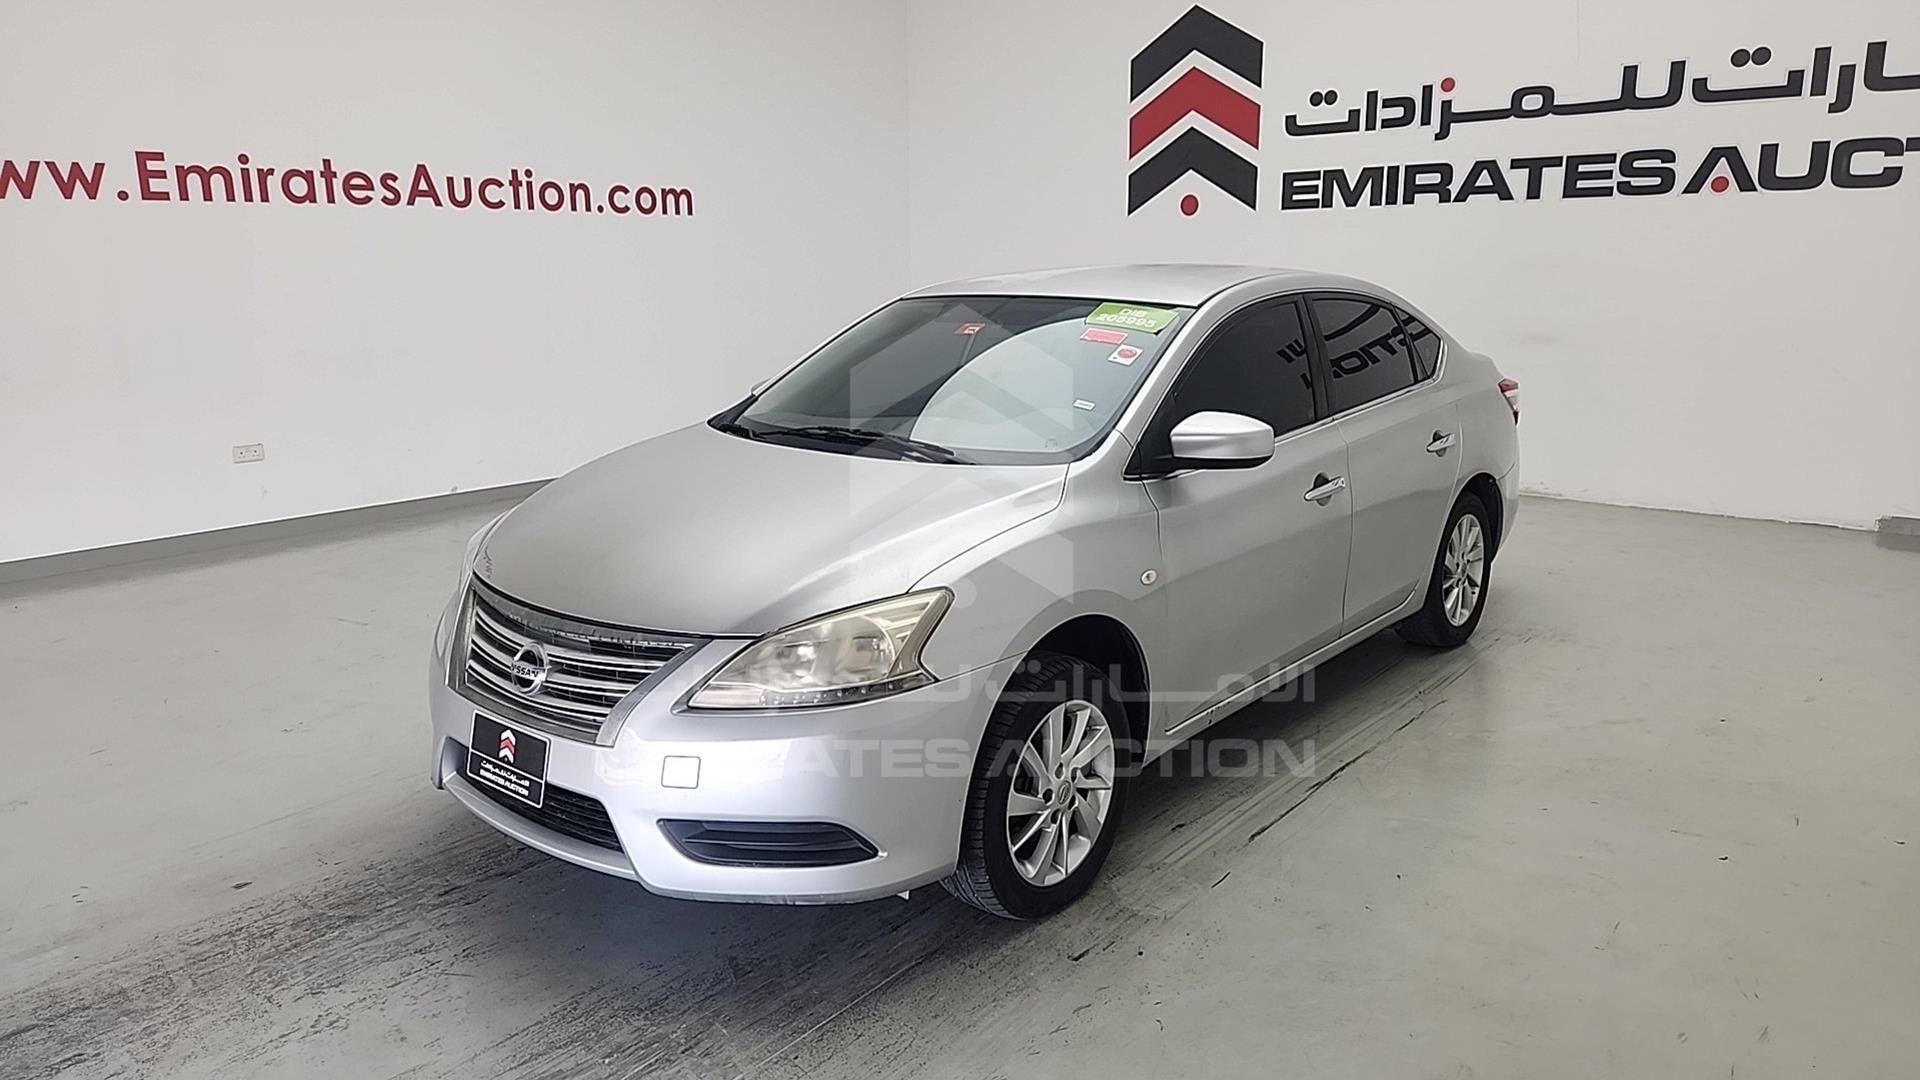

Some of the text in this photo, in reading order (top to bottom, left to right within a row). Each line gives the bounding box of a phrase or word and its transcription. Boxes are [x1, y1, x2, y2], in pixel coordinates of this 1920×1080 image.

[1285, 60, 1687, 140] للمزادات
[1280, 136, 1920, 210] EMIRATES AUC
